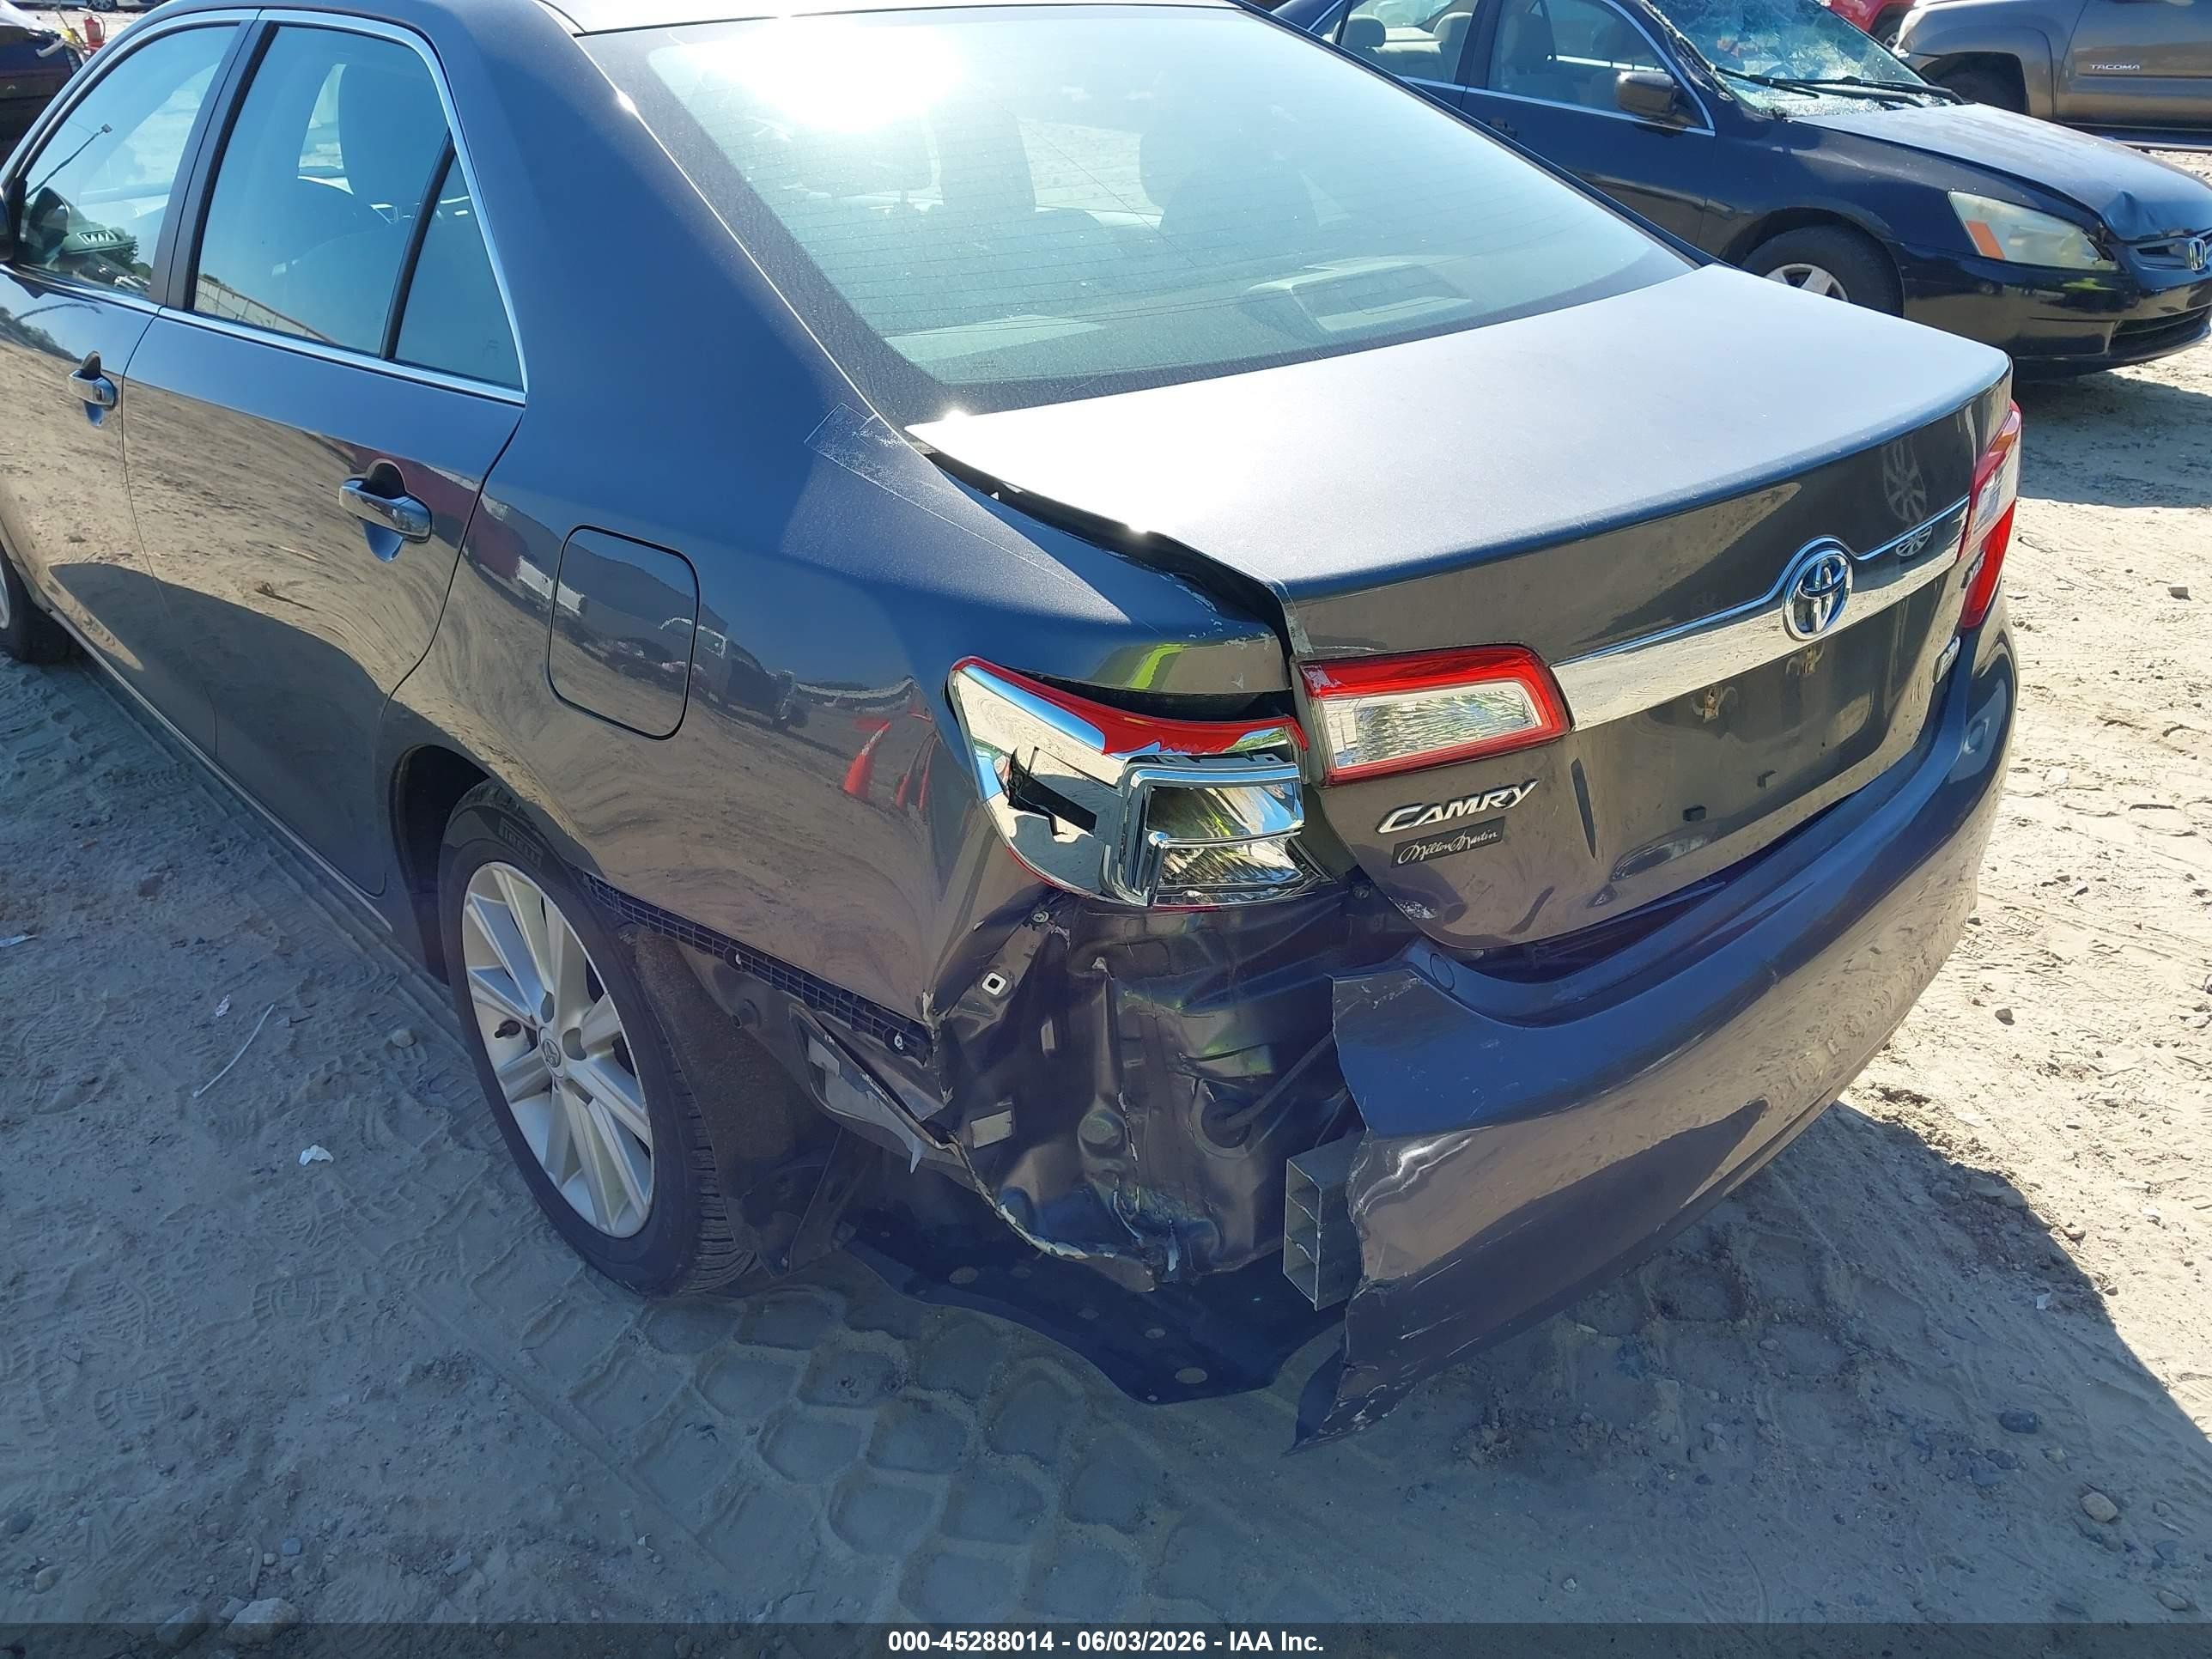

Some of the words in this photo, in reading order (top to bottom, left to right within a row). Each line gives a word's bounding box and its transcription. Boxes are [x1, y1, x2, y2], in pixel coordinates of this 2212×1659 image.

[1376, 779, 1540, 834] CAMRY
[1397, 839, 1452, 865] Milton
[1449, 829, 1498, 851] Martin
